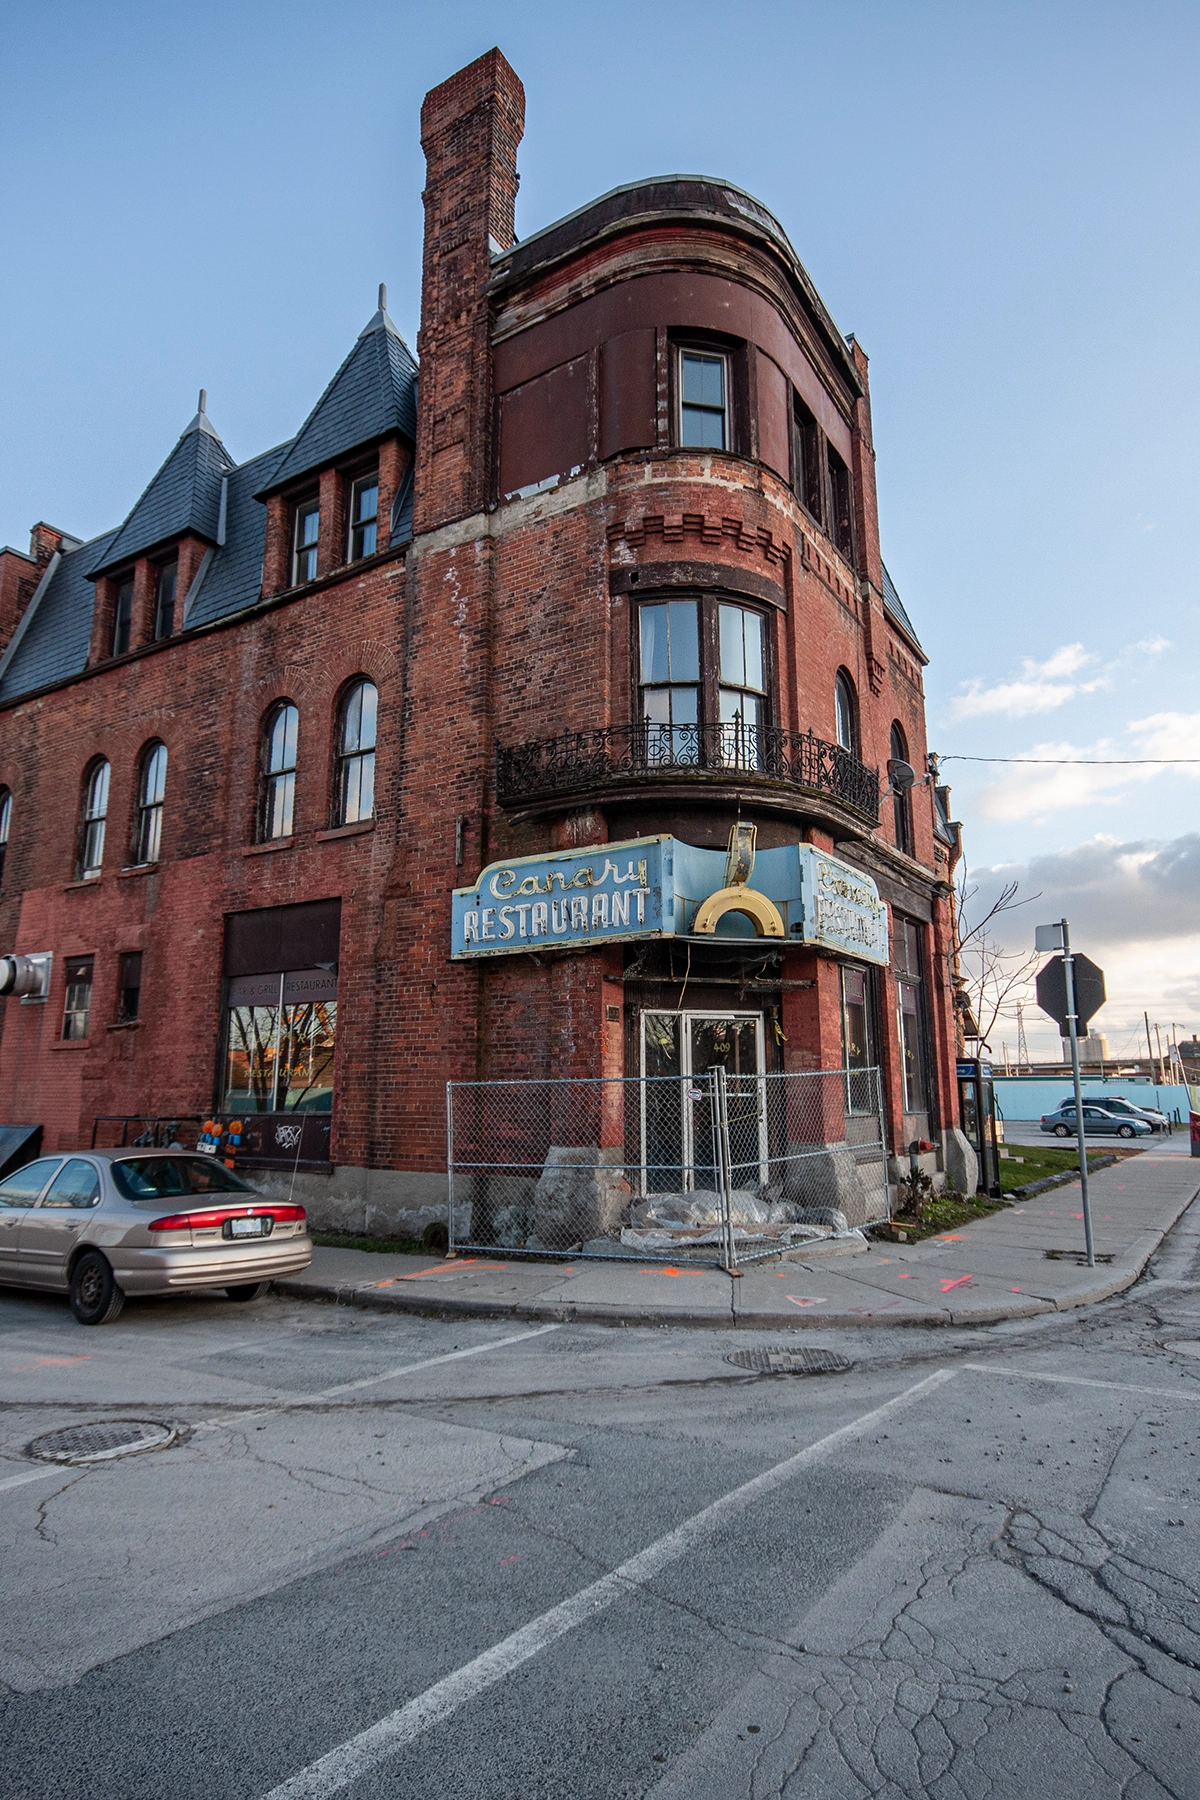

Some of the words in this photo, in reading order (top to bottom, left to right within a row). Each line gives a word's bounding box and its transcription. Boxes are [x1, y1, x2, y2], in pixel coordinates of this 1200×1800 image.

[489, 858, 647, 900] Canary
[464, 887, 650, 944] RESTAURANT
[257, 983, 278, 995] GRILL
[286, 978, 338, 991] RESTAURANT
[713, 1042, 731, 1052] 409
[243, 1068, 317, 1078] RESTAURANT
